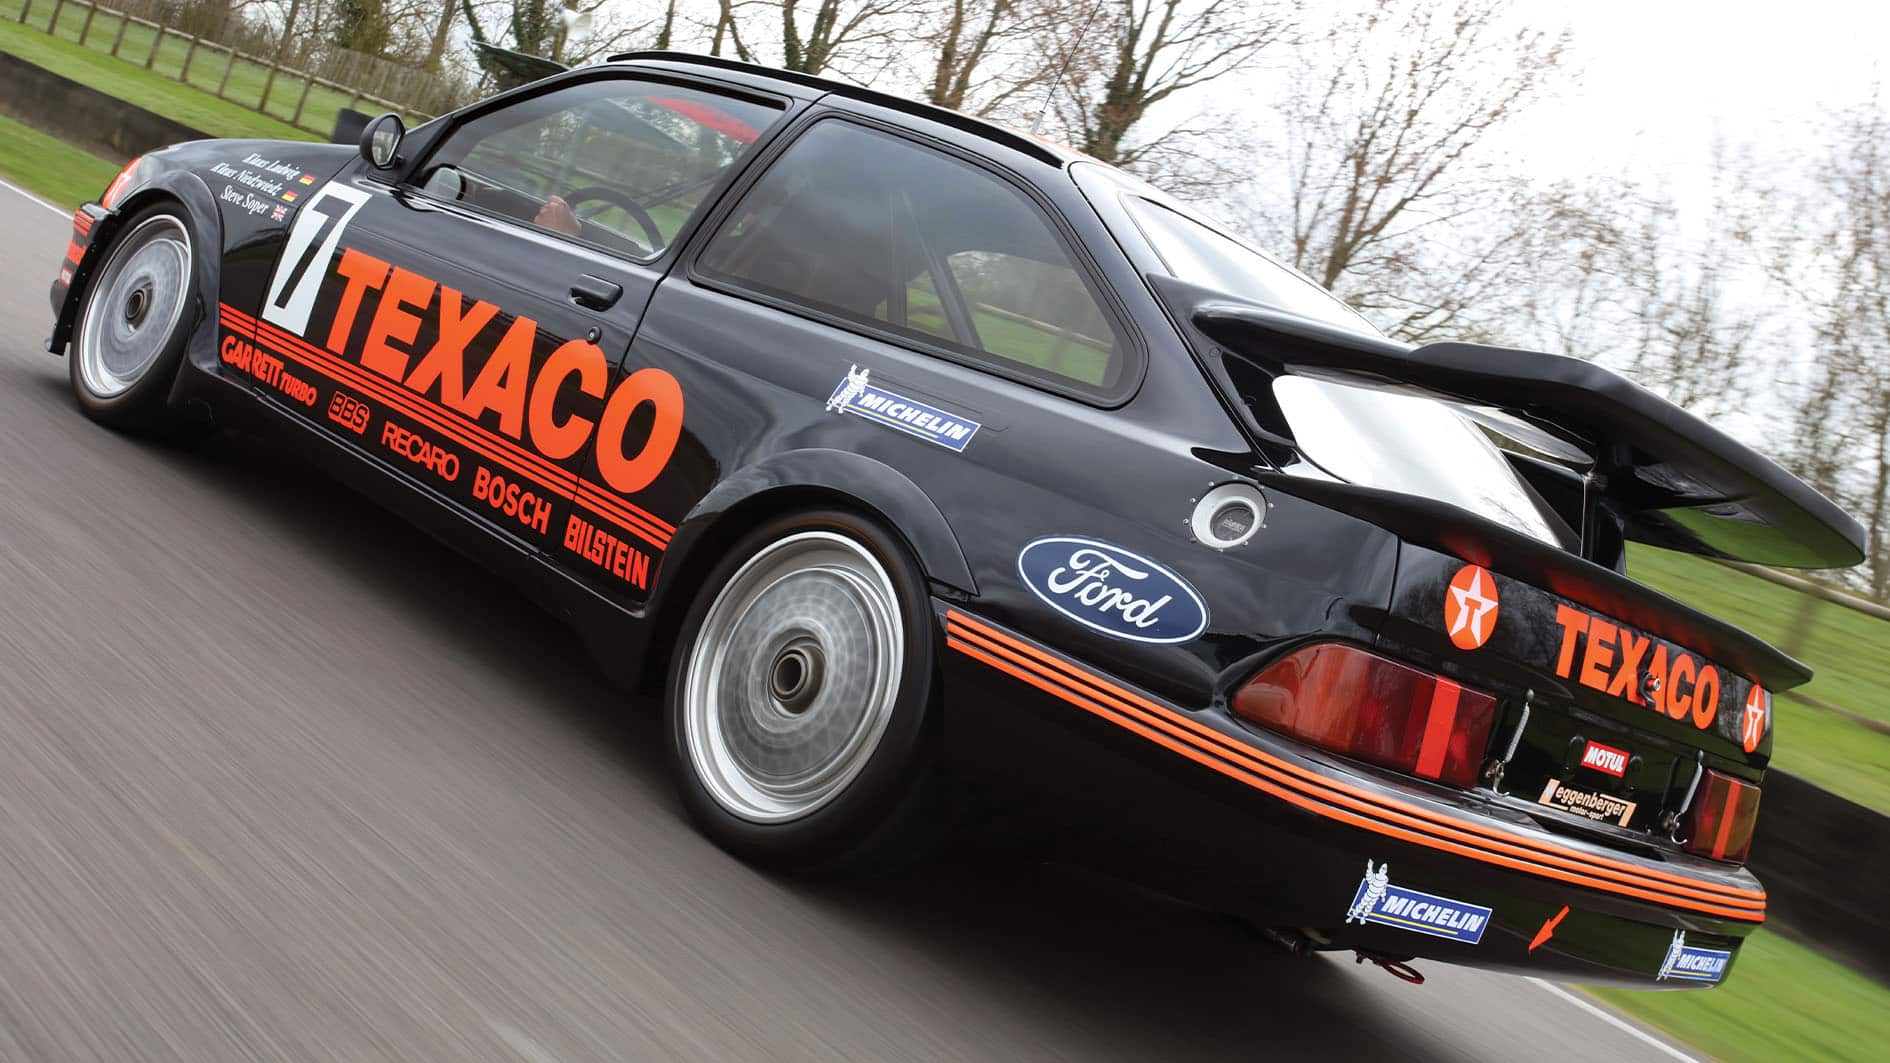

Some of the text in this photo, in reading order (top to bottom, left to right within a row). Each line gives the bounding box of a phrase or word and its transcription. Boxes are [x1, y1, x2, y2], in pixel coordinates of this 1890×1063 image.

[210, 162, 238, 178] Klaus
[242, 153, 301, 181] Klaus Ludwig
[220, 184, 269, 215] Steve Soper
[269, 187, 363, 322] 7
[221, 335, 317, 407] GARRETT TURBO
[326, 247, 684, 494] TEXACO
[328, 390, 371, 435] BBS
[857, 392, 971, 440] MICHELIN
[381, 420, 460, 481] RECARO
[472, 465, 552, 535] BOSCH
[563, 514, 650, 590] BILSTEIN
[1048, 549, 1173, 628] Ford
[1555, 603, 1720, 730] TEXACO
[1583, 745, 1625, 773] MOTUL
[1555, 786, 1626, 817] eggenberger
[1381, 895, 1485, 932] MICHELIN
